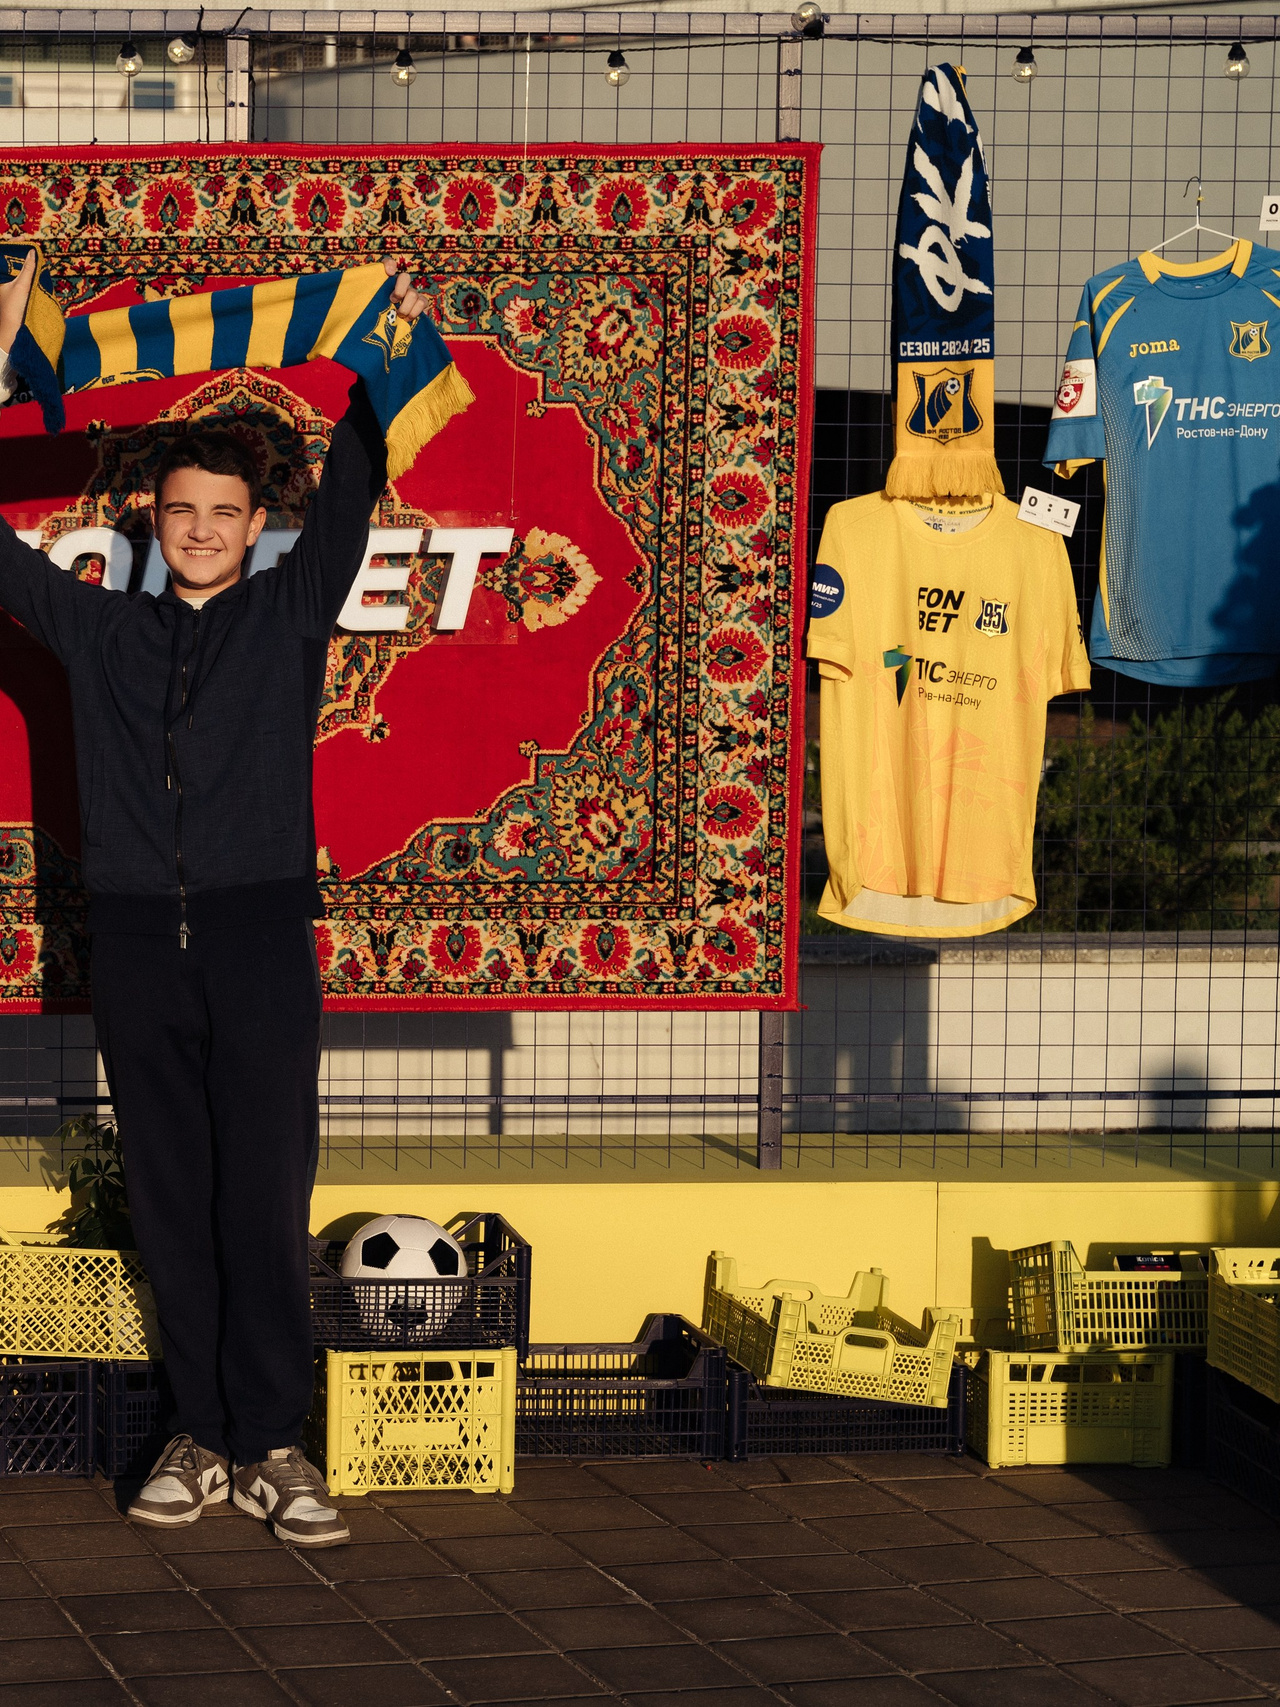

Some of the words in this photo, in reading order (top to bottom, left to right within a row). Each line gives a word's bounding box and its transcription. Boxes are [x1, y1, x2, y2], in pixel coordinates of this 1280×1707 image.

[1269, 203, 1279, 215] 0
[900, 342, 940, 356] СЕЗОН
[942, 338, 990, 355] 2024/25
[1174, 396, 1226, 421] ТНС
[1226, 403, 1280, 418] ЭНЕРГО
[1176, 424, 1269, 440] Ростов-на-Дону
[1028, 495, 1038, 507] 0
[1063, 508, 1070, 519] 1
[918, 587, 965, 611] FON
[918, 610, 958, 633] BET
[983, 602, 1002, 629] 95
[946, 670, 998, 690] ЭНЕРГО
